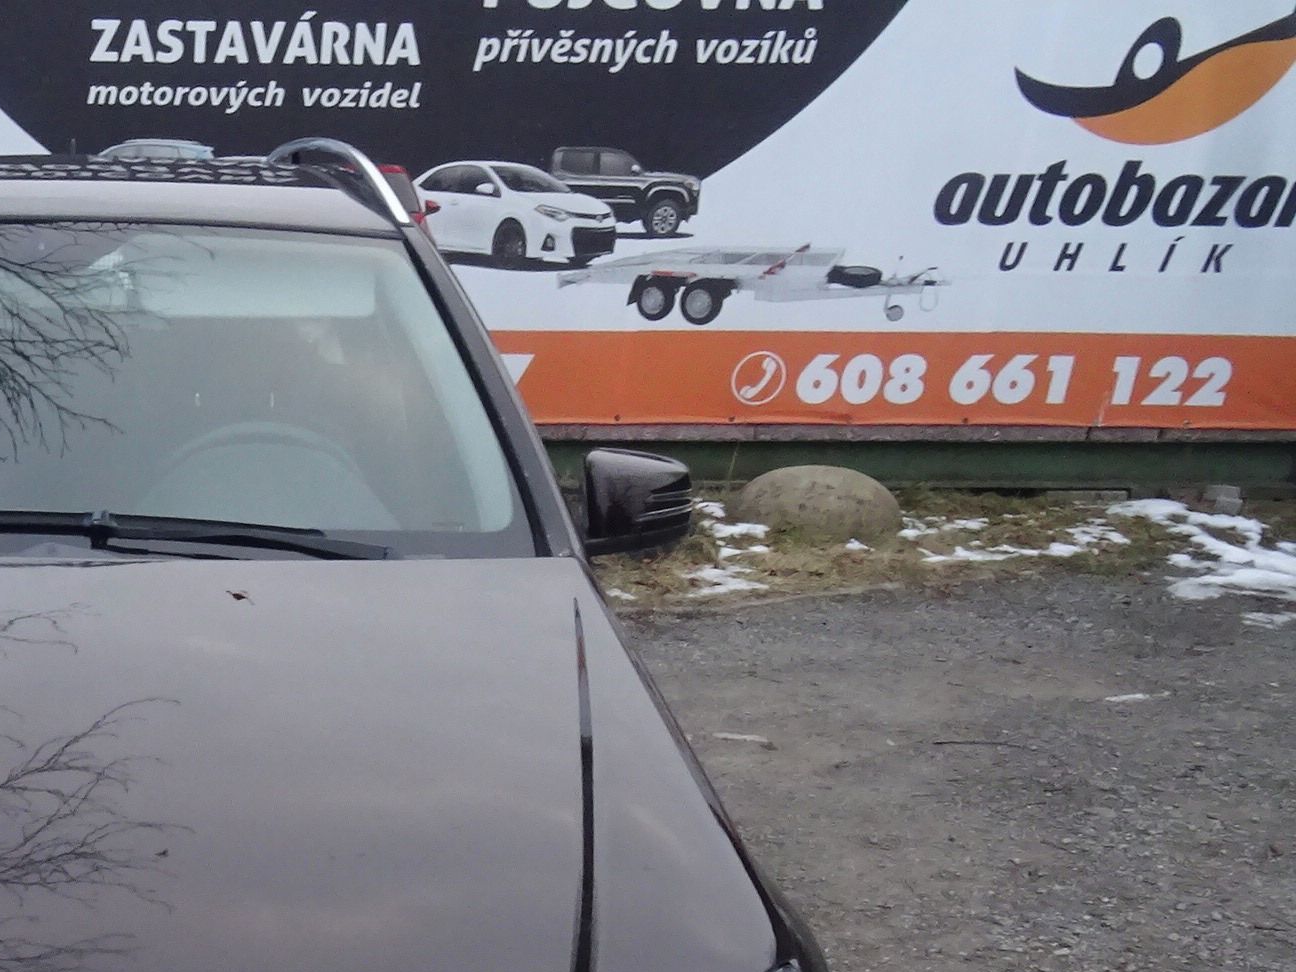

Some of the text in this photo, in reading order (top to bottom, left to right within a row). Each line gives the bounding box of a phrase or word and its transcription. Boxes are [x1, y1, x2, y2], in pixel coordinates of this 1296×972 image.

[89, 11, 421, 65] ZASTAVÁRNA
[473, 27, 818, 73] přívěsných vozíků
[87, 81, 422, 114] motorových vozidel
[796, 354, 1234, 406] 608 661 122
